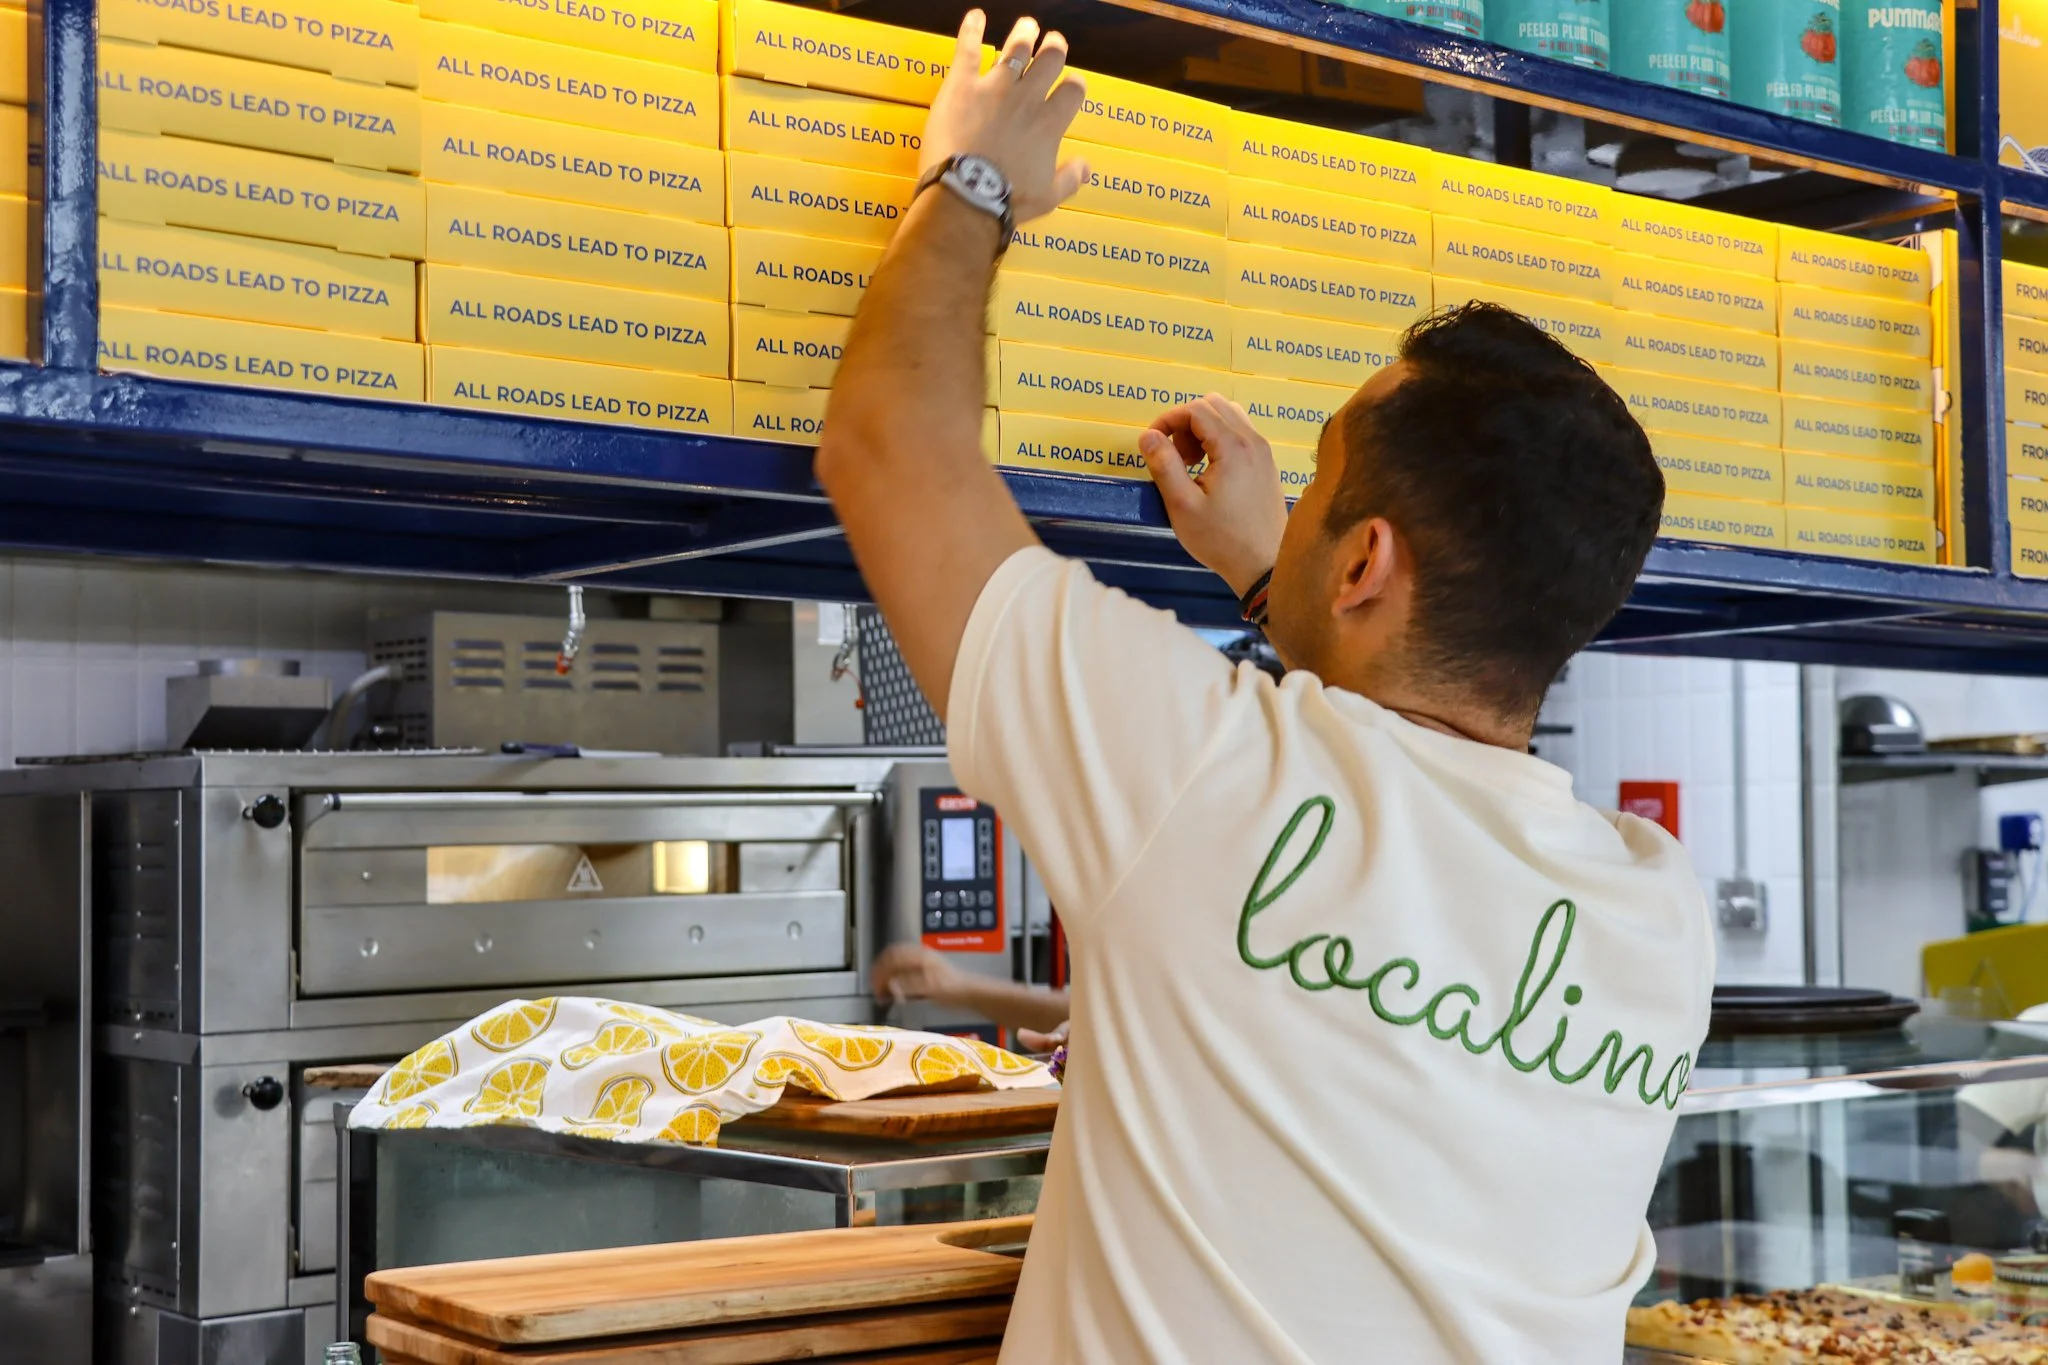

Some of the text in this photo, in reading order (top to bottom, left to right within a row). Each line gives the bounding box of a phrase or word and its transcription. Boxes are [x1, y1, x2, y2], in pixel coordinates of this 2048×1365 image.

[228, 4, 393, 50] LEAD TO PIZZA
[556, 0, 605, 21] LEAD
[612, 11, 636, 28] TO
[643, 17, 695, 41] PIZZA
[1519, 22, 1558, 38] PEELED
[756, 31, 787, 48] ALL
[793, 37, 851, 60] ROADS
[857, 49, 899, 69] LEAD
[905, 58, 925, 74] TO
[1649, 54, 1687, 69] PEELED
[438, 56, 696, 116] ALL ROADS LEAD TO PIZZA
[140, 77, 222, 106] ROADS
[231, 93, 290, 116] LEAD
[297, 104, 326, 123] TO
[334, 110, 395, 135] PIZZA
[1108, 106, 1146, 125] LEAD
[1150, 115, 1168, 131] TO
[1173, 121, 1212, 142] PIZZA
[749, 110, 921, 150] ALL ROADS LEAD TO
[443, 137, 702, 192] ALL ROADS LEAD TO PIZZA
[1243, 140, 1416, 184] ALL ROADS LEAD TO PIZZA
[146, 168, 228, 196] ROADS
[236, 182, 294, 205] LEAD
[301, 192, 330, 211] TO
[337, 197, 399, 222] PIZZA
[752, 185, 899, 219] ALL ROADS LEAD
[1104, 176, 1142, 194] LEAD
[1147, 184, 1165, 199] TO
[1170, 188, 1210, 208] PIZZA
[1442, 180, 1598, 219] ALL ROADS LEAD TO PIZZA
[449, 219, 707, 270] ALL ROADS LEAD TO PIZZA
[1243, 204, 1416, 246] ALL ROADS LEAD TO PIZZA
[1011, 231, 1210, 274] ALL ROADS LEAD TO PIZZA
[1447, 241, 1600, 279] ALL ROADS LEAD TO PIZZA
[1790, 251, 1919, 283] ALL ROADS LEAD TO PIZZA
[99, 252, 389, 306] LL ROADS LEAD TO PIZZA
[756, 261, 788, 278] ALL
[794, 266, 853, 286] ROADS
[1241, 270, 1416, 308] ALL ROADS LEAD TO PIZZA
[1621, 276, 1763, 310] ALL ROADS LEAD TO PIZZA
[450, 300, 706, 346] ALL ROADS LEAD TO PIZZA
[1016, 301, 1213, 342] ALL ROADS LEAD TO PIZZA
[146, 346, 227, 370] ROADS
[236, 356, 293, 377] LEAD
[300, 363, 329, 382] TO
[337, 368, 397, 390] PIZZA
[756, 338, 843, 360] ALL ROAD
[1247, 336, 1272, 351] ALL
[1276, 340, 1323, 358] ROADS
[1327, 347, 1360, 363] LEAD
[1365, 353, 1381, 366] TO
[454, 382, 709, 423] ALL ROADS LEAD TO PIZZA
[1018, 372, 1046, 388] ALL
[1051, 376, 1103, 395] ROADS
[1109, 384, 1146, 400] LEAD
[1151, 389, 1170, 403] TO
[753, 414, 785, 430] ALL
[1248, 403, 1324, 424] ALL ROADS
[1628, 394, 1769, 424] ALL ROADS LEAD TO PIZZA
[1017, 442, 1146, 468] ALL ROADS LEAD
[1237, 794, 1691, 1111] localino
